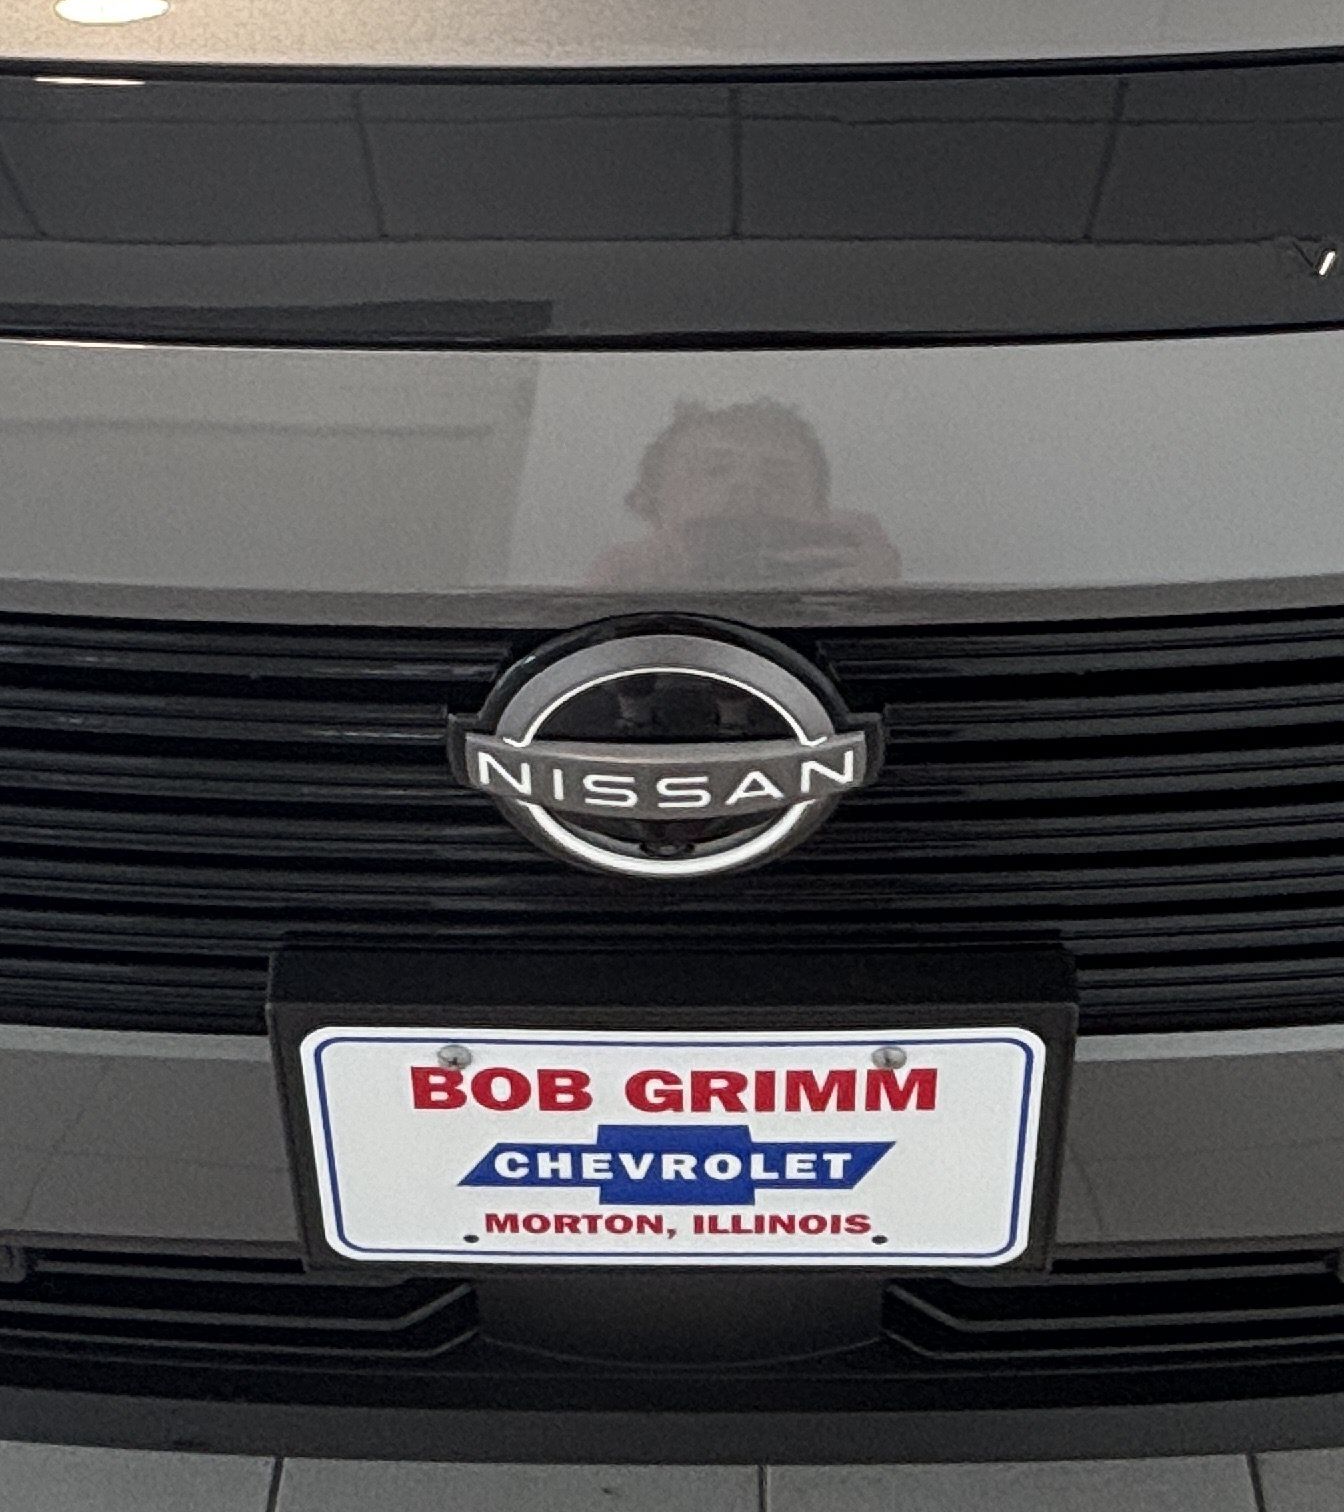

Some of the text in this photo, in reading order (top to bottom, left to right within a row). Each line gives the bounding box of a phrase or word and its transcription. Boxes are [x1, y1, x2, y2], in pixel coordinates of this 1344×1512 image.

[478, 750, 854, 808] NISSAN
[410, 1066, 938, 1113] BOB GRIMM
[493, 1151, 853, 1181] CHEVROLET
[485, 1213, 872, 1239] MORTON, ILLINOIS
